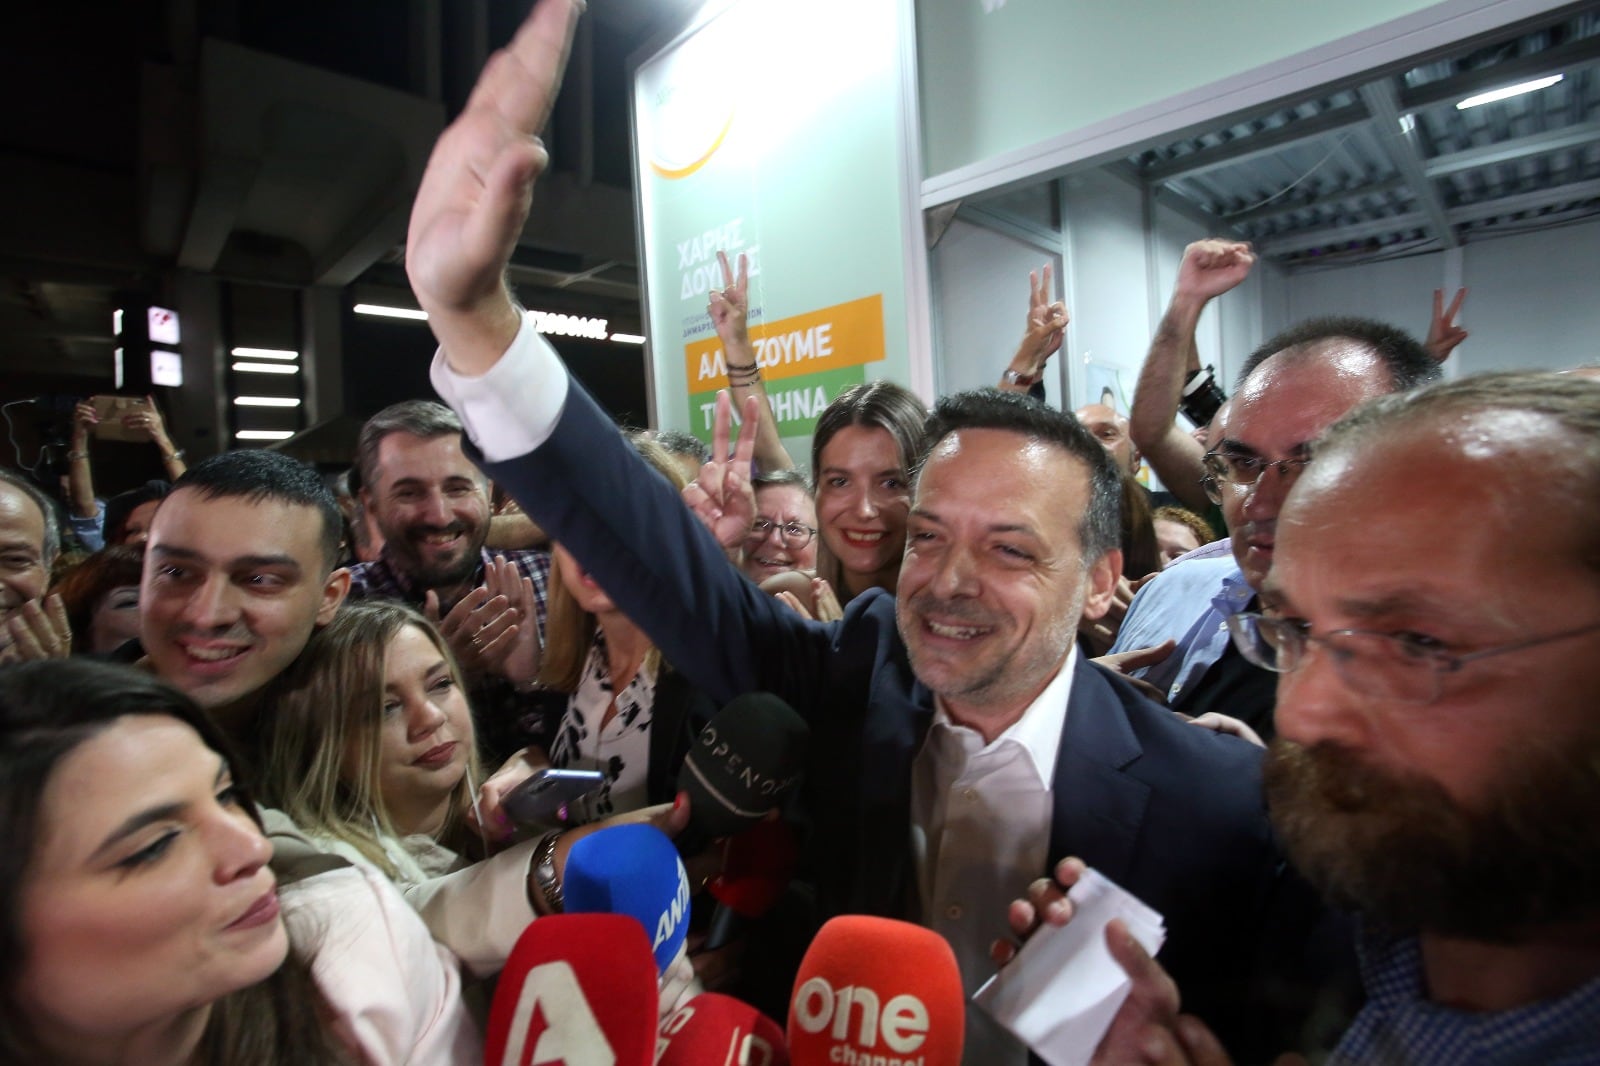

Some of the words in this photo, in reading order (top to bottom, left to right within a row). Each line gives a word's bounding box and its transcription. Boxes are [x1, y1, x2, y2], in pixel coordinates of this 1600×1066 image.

[697, 322, 834, 381] ΑΛΖΟΥΜΕ
[701, 727, 761, 789] OPEN
[795, 977, 930, 1055] one
